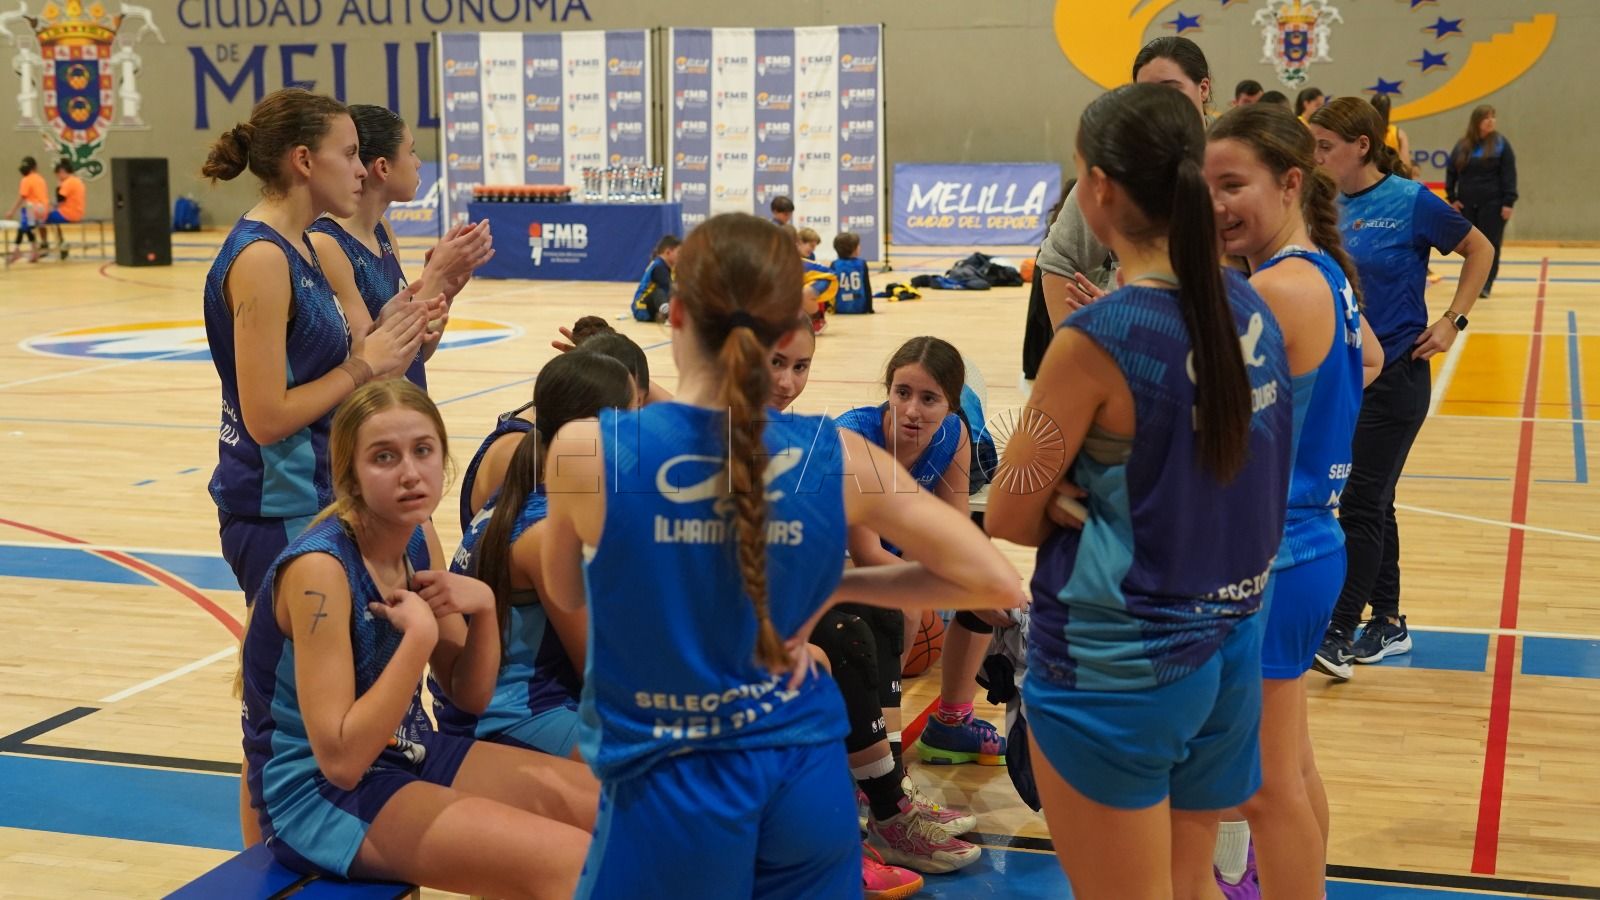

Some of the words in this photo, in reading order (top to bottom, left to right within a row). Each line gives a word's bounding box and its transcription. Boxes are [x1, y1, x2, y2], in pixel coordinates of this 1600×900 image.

[177, 0, 322, 28] CIUDAD
[217, 44, 239, 63] DE
[906, 181, 1048, 215] MELILLA
[542, 223, 588, 249] FMB
[959, 215, 983, 229] DEL
[987, 215, 1040, 229] DEPORTE
[839, 271, 861, 291] 46
[1250, 380, 1278, 413] OURS
[654, 514, 725, 543] ILHAM
[304, 590, 328, 634] 7
